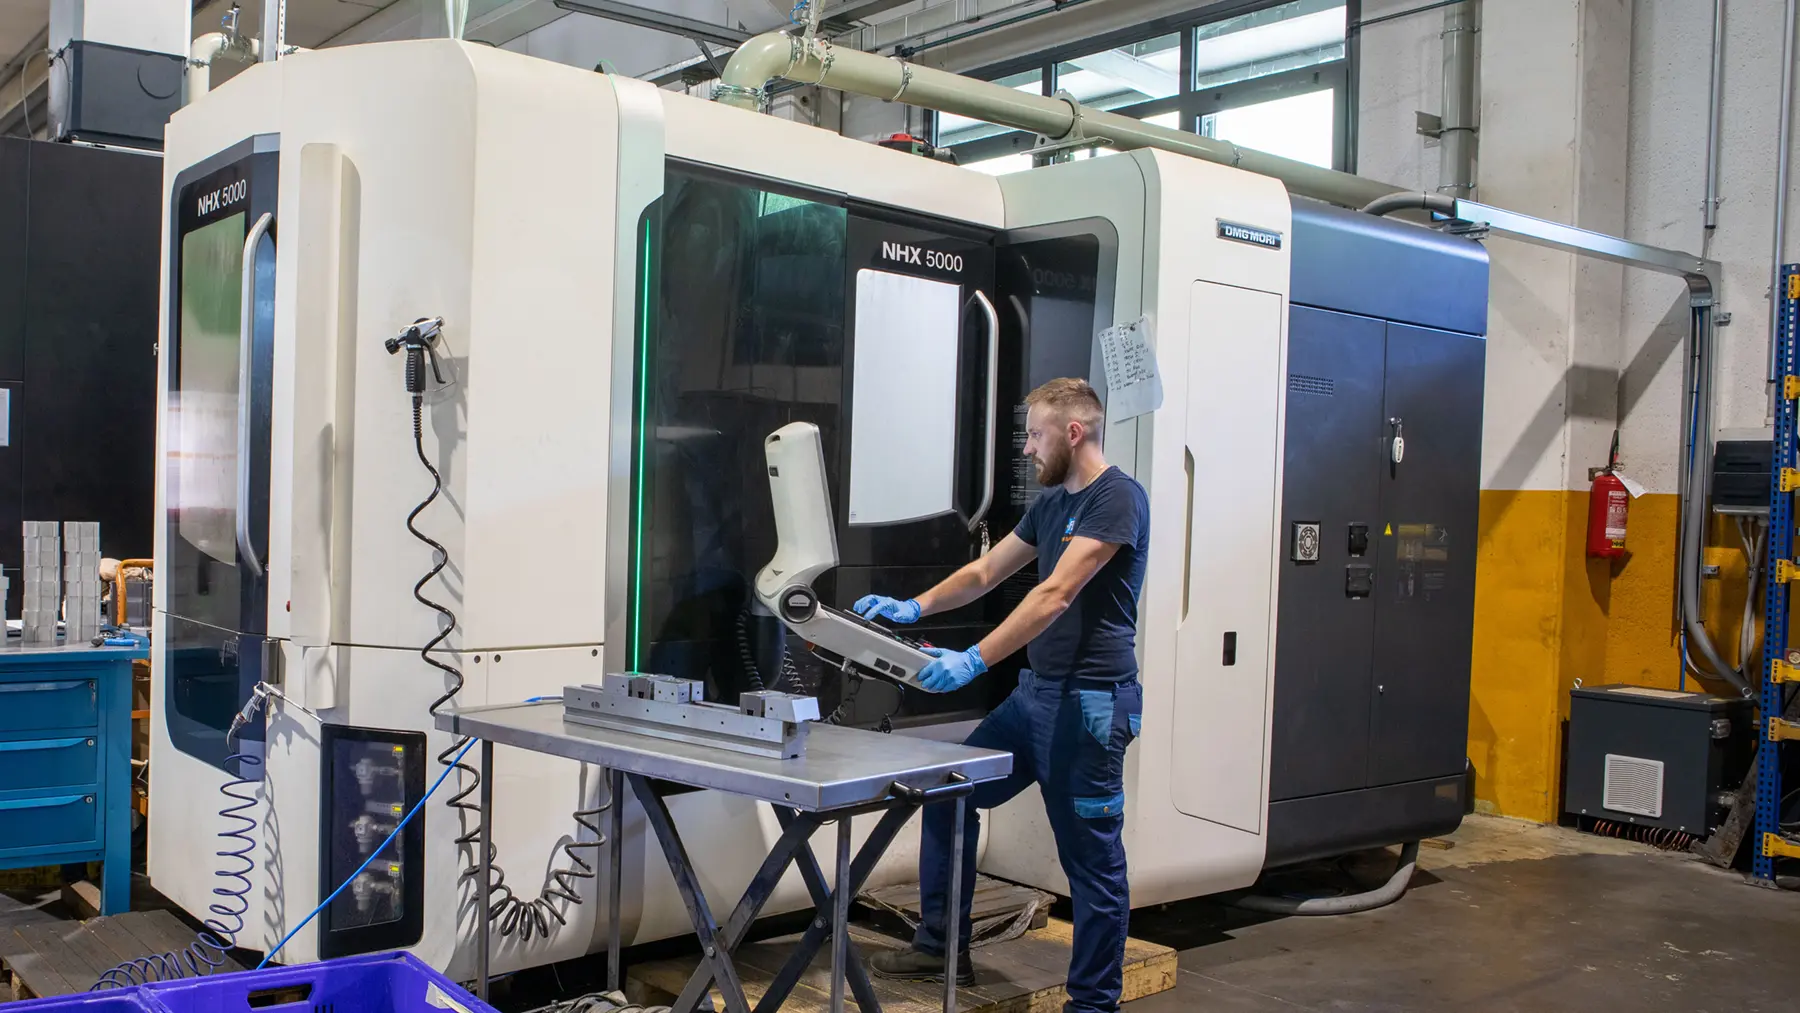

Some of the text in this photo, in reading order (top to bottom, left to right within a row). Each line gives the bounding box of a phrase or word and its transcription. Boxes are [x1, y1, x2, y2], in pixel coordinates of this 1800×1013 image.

[197, 179, 247, 217] NHX 5000
[1225, 225, 1276, 246] DMG MORI
[882, 241, 963, 273] NHX 5000
